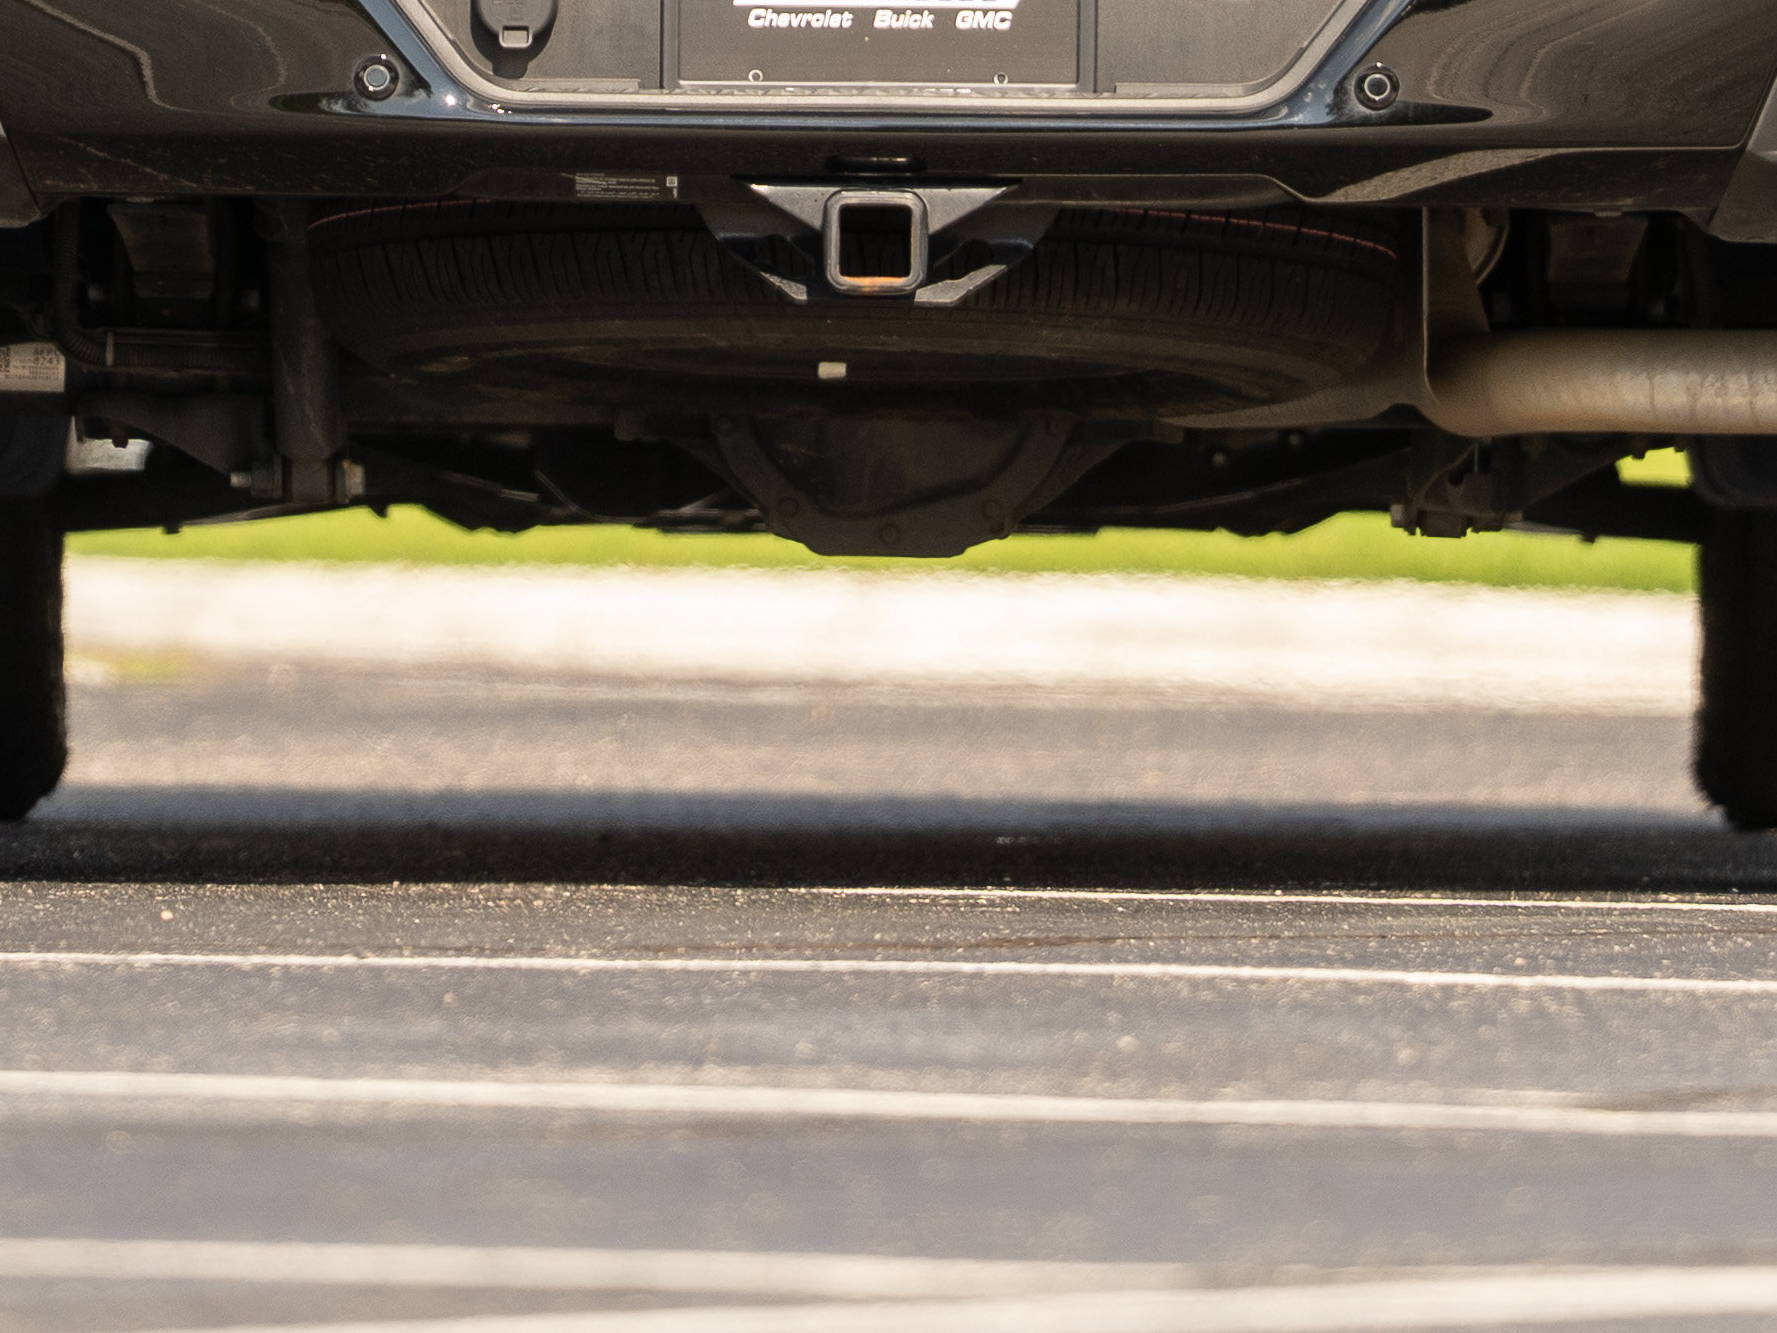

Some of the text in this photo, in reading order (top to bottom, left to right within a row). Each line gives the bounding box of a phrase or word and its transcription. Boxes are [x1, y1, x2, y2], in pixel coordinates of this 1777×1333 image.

[747, 7, 1014, 31] Chevrolet Buick GMC
